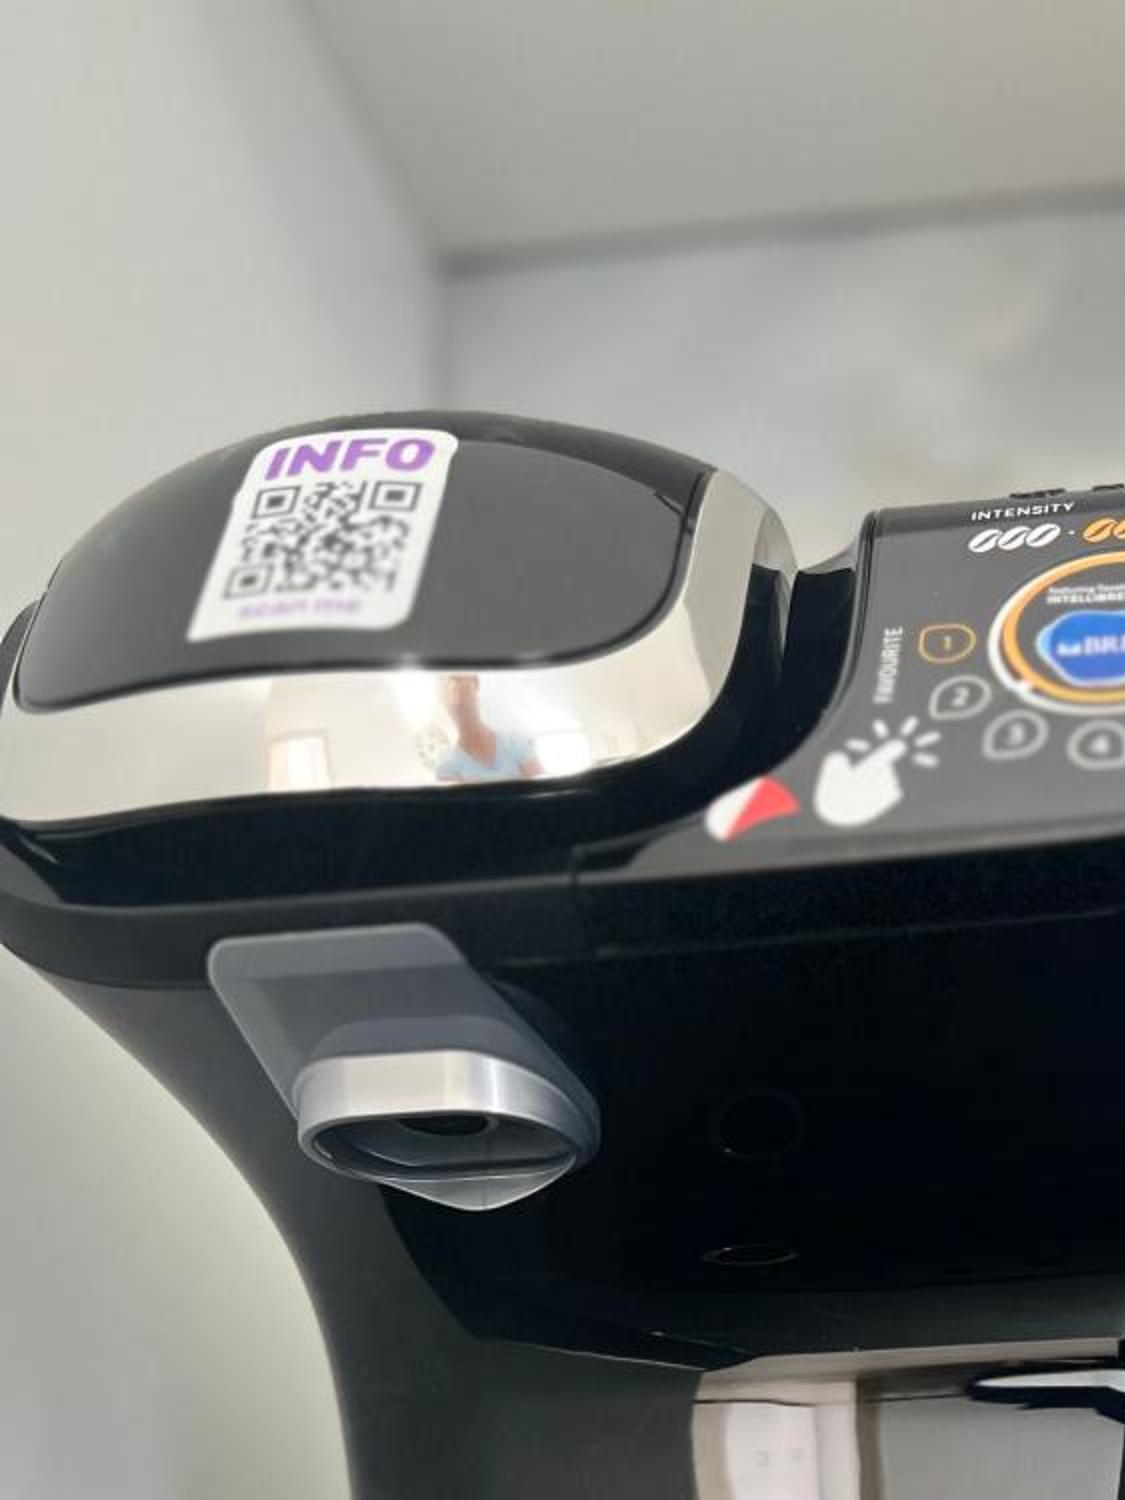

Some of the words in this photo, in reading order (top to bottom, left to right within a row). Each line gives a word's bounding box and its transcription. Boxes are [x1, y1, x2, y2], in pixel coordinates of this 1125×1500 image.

[265, 438, 436, 481] INFO
[971, 501, 1075, 522] INTENSITY
[950, 686, 970, 707] 2
[1006, 723, 1026, 747] 3
[1090, 734, 1110, 755] 4
